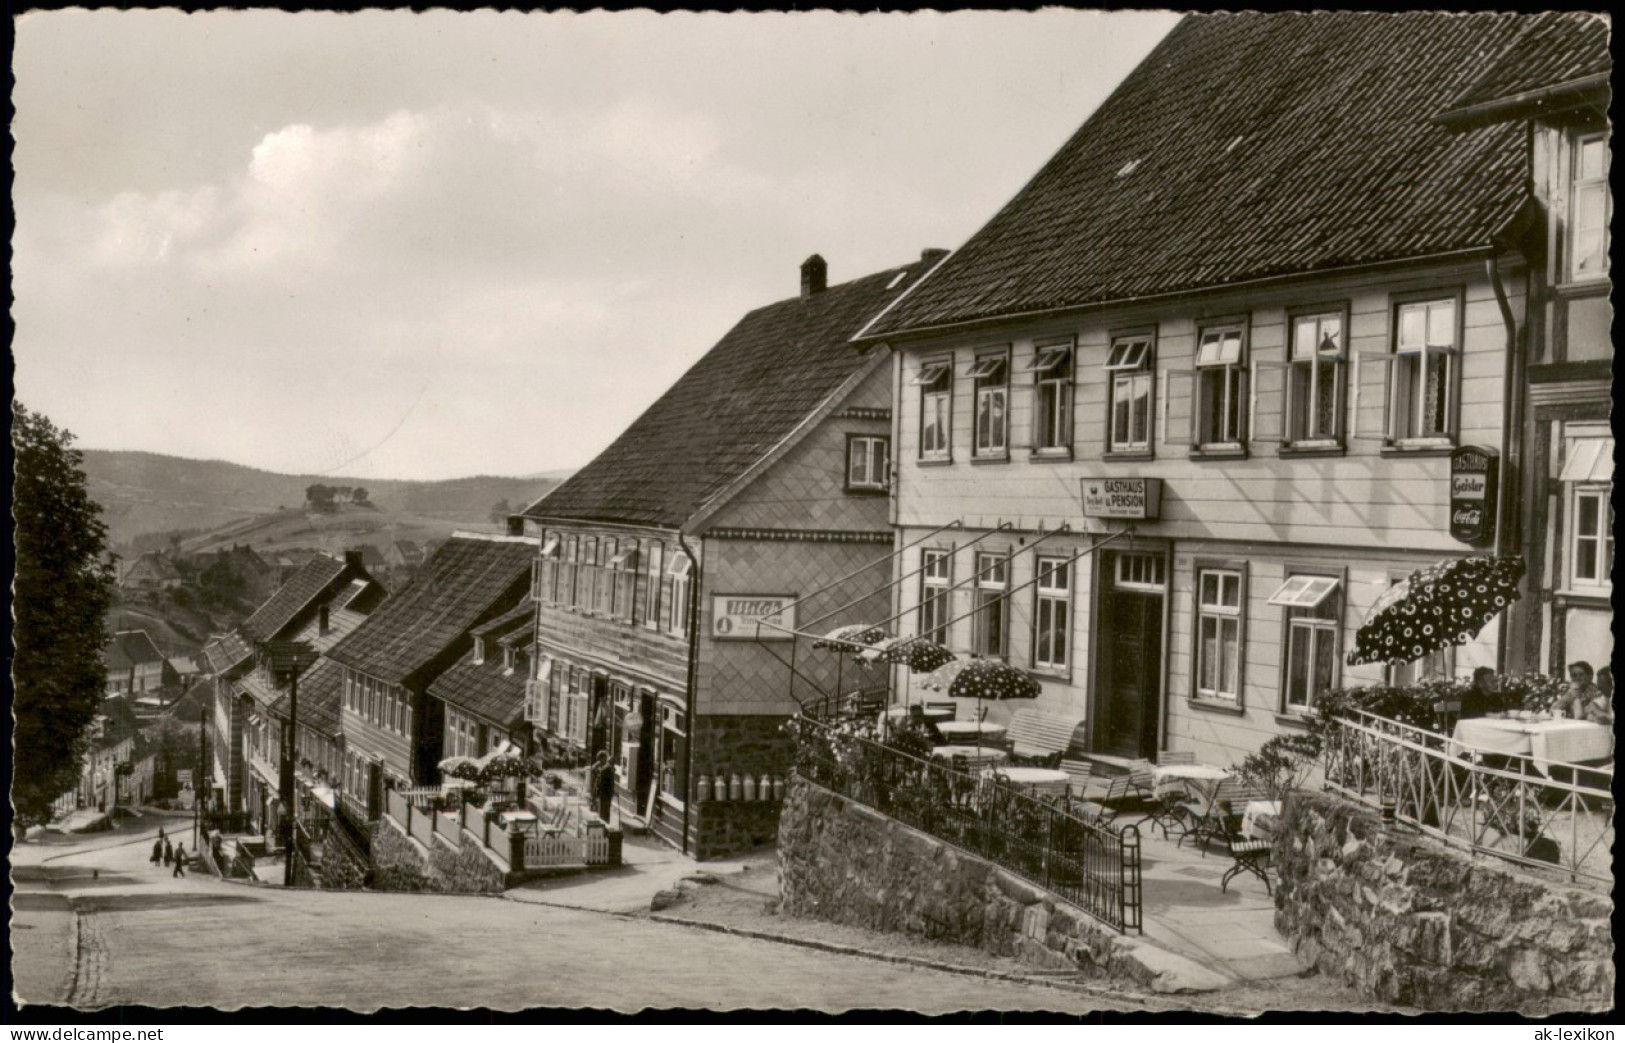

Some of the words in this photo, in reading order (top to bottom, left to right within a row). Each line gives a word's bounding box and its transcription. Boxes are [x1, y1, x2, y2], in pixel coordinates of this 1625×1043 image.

[1105, 481, 1143, 493] GASTHAUS
[1454, 478, 1484, 495] Geisler
[1111, 495, 1144, 507] PENSION
[730, 601, 780, 615] Milch
